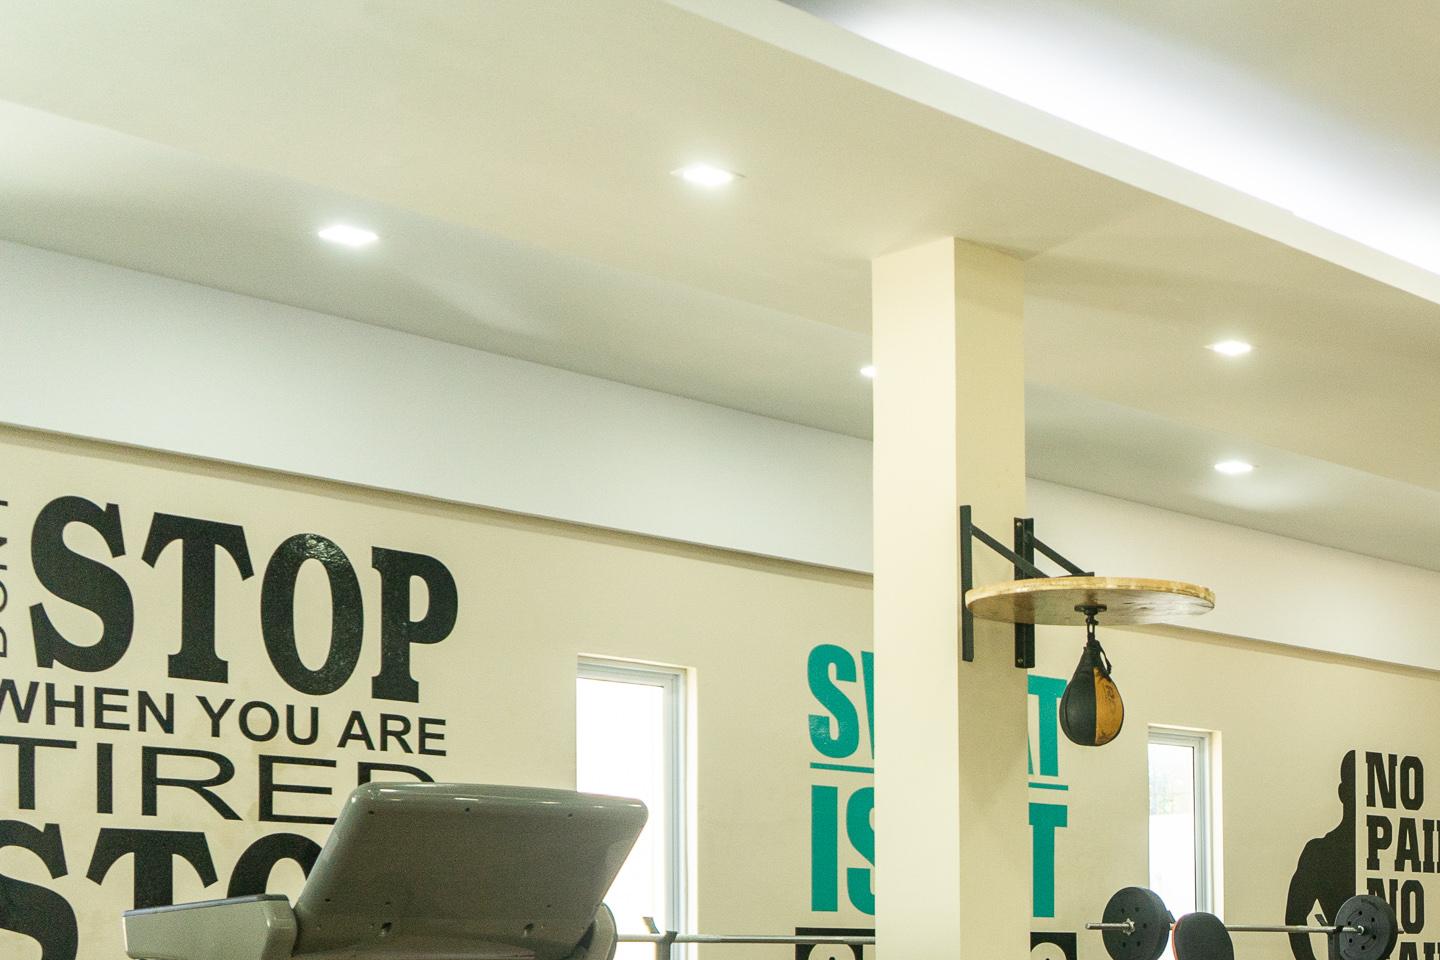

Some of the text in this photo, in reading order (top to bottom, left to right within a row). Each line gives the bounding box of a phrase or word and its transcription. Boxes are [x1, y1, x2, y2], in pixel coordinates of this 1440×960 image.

[29, 496, 459, 704] STOP
[0, 679, 447, 757] WHEN YOU ARE
[1365, 751, 1424, 811] NO
